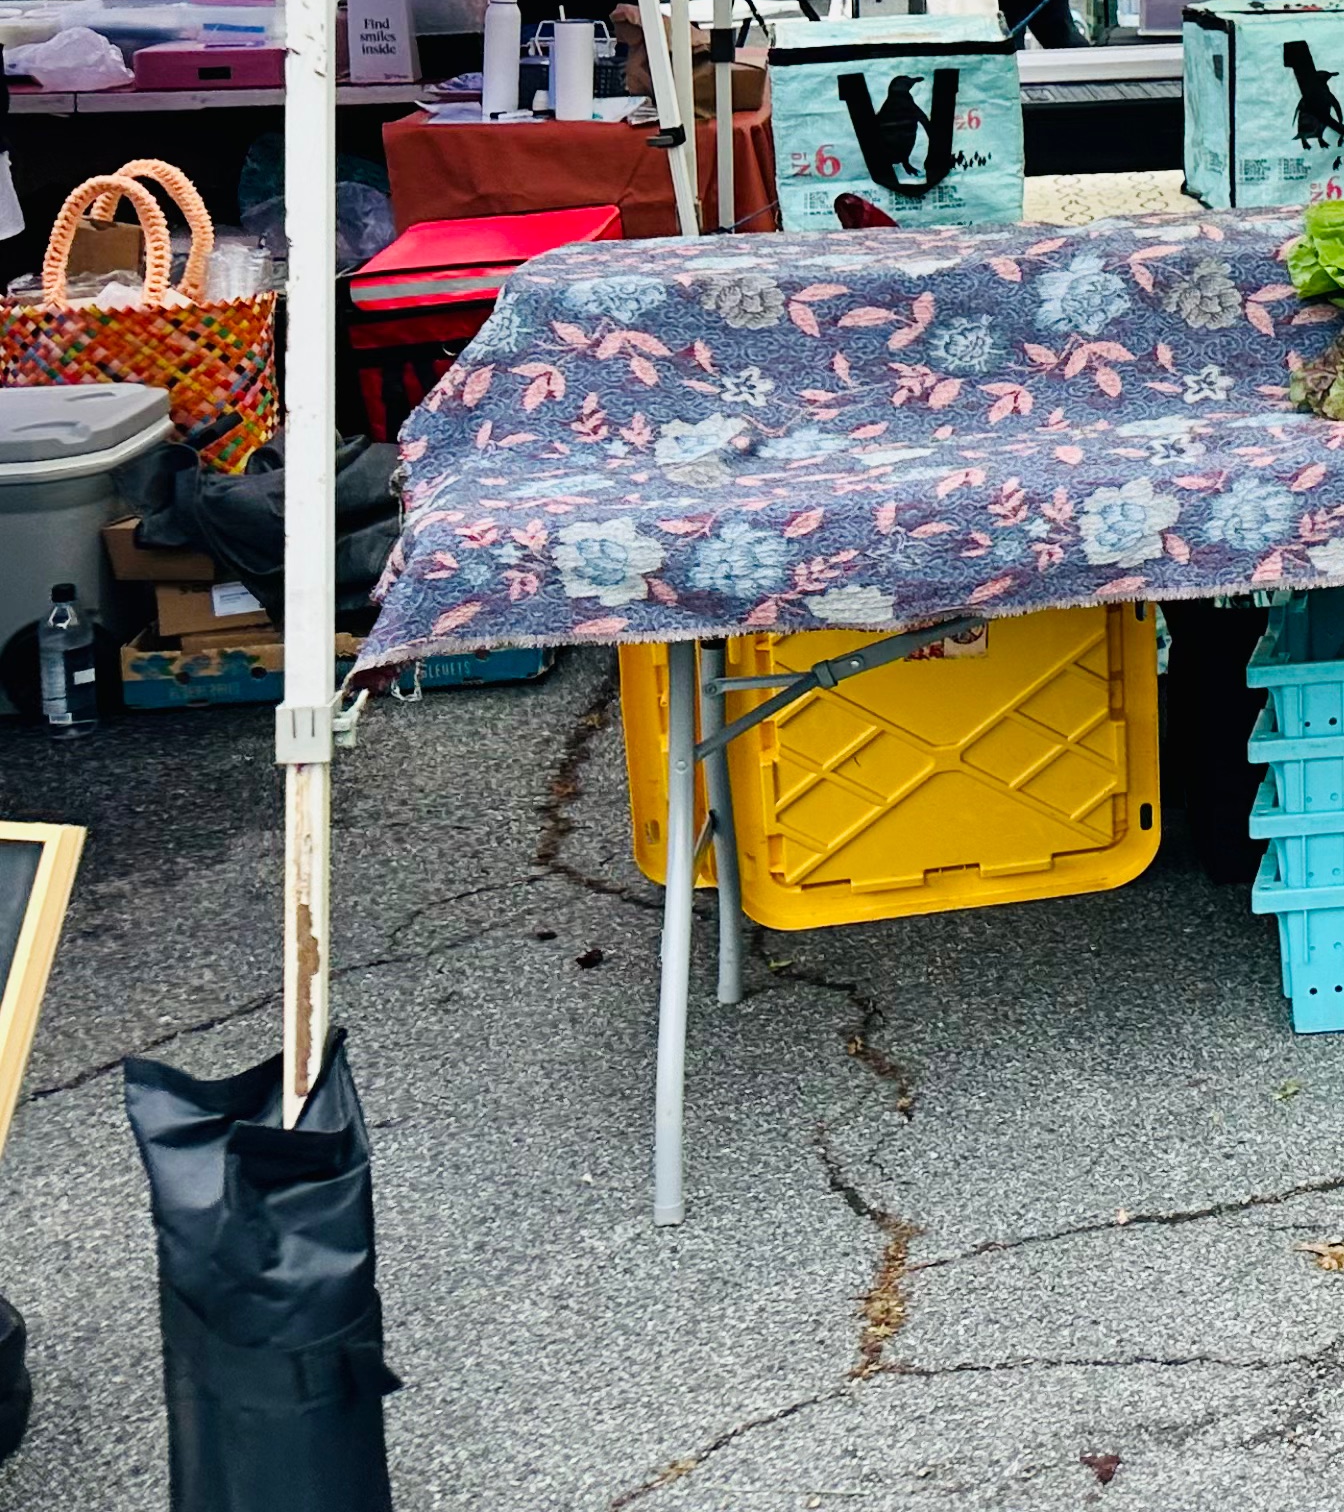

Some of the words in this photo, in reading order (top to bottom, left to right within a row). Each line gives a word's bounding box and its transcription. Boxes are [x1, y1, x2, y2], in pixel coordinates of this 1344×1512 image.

[364, 18, 390, 30] Find
[360, 31, 397, 42] smiles
[362, 44, 397, 55] inside
[815, 144, 842, 178] 6
